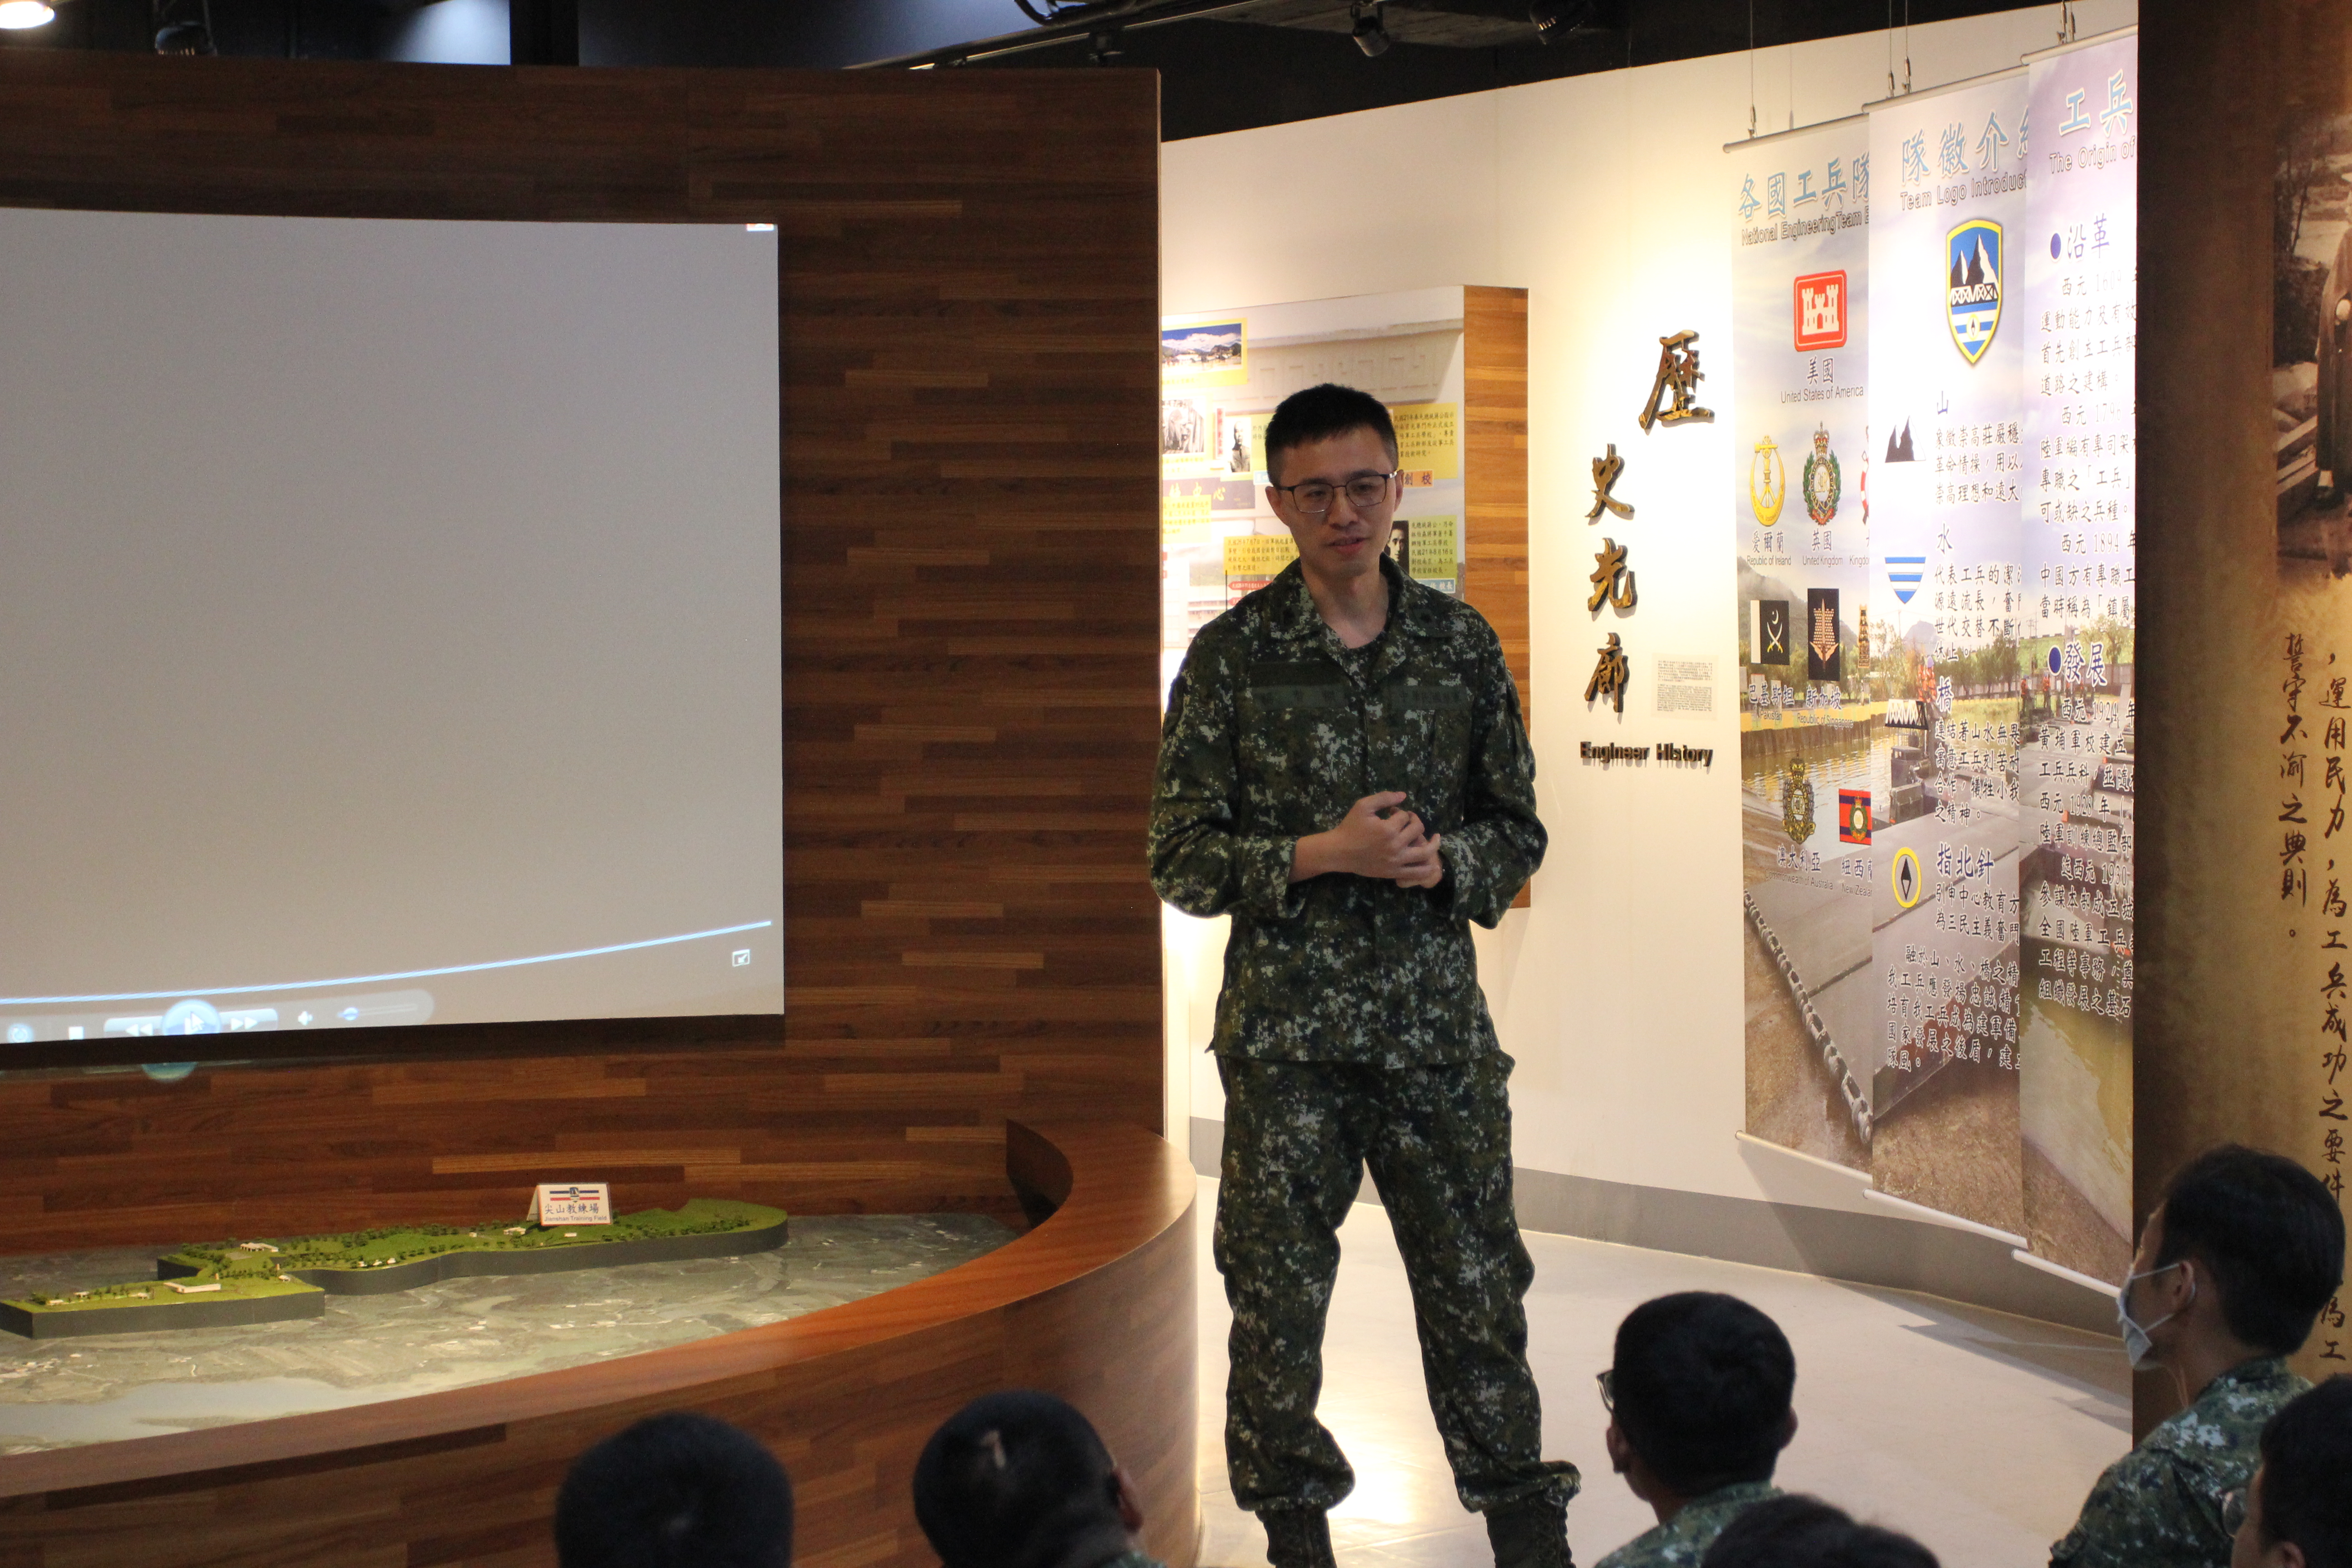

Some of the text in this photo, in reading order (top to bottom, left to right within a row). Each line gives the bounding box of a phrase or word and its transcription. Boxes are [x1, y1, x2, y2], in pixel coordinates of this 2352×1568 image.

[2059, 69, 2133, 137] 工兵
[2049, 135, 2136, 174] The Origin of
[1738, 151, 1870, 221] 各國工兵隊
[1900, 190, 1931, 211] Team
[1937, 185, 1967, 206] Logo
[1742, 223, 1778, 245] National
[2067, 211, 2110, 260] 沿革
[2062, 275, 2087, 296] 西元
[1807, 355, 1834, 386] 美國
[2041, 368, 2119, 397] 道路之建構。
[1780, 384, 1864, 404] United States of America
[1937, 390, 1949, 415] 山
[2062, 404, 2087, 426] 西元
[2095, 401, 2121, 422] 1796
[1935, 422, 2023, 450] 象徵崇高莊嚴穩
[1935, 452, 2023, 477] 革命情操，用以
[1935, 478, 2023, 505] 崇高理想和遠大
[2040, 465, 2130, 493] 專職之「工兵」
[2040, 498, 2128, 524] 可或缺之兵種。
[1751, 530, 1784, 554] 愛爾蘭
[1811, 529, 1833, 552] 英國
[1937, 523, 1953, 555] 水
[2062, 533, 2087, 554] 西元
[2093, 531, 2120, 553] 1894
[1747, 555, 1791, 566] Republic of Ireland
[1802, 556, 1843, 567] United Kingdom
[1935, 614, 2021, 640] 世代交替不斷
[1935, 641, 1970, 663] 休止。
[2063, 640, 2108, 687] 發展
[1749, 680, 1795, 706] 巴基斯坦
[1806, 686, 1842, 710] 新加坡
[1936, 676, 1954, 713] 橋
[1760, 710, 1783, 721] Pakistan
[1797, 711, 1854, 729] Republic of Singapore
[2062, 698, 2087, 722] 西元
[2092, 700, 2119, 723] 1924
[2038, 724, 2127, 756] 黃埔軍校建立
[1580, 741, 1713, 767] Engineer History
[1935, 799, 1981, 827] 之精神。
[2039, 791, 2064, 815] 西元
[2069, 794, 2093, 817] 1928
[2039, 819, 2132, 858] 陸軍訓練總監部
[1777, 843, 1821, 873] 澳大利亞
[1937, 842, 1994, 885] 指北針
[2061, 853, 2127, 886] 迄西元 1930
[1804, 876, 1809, 886] of
[1810, 877, 1833, 890] Australia
[1842, 882, 1853, 894] New
[1936, 883, 2020, 915] 引申中心教育方
[1935, 908, 2020, 947] 為三民主義奮鬥
[2038, 914, 2134, 955] 全國陸軍工兵
[2038, 977, 2132, 1018] 組織發展之基石
[1886, 993, 2020, 1044] 培育我工兵成為建軍備
[1887, 1046, 1921, 1073] 隊風。
[544, 1203, 599, 1215] 尖山教練場
